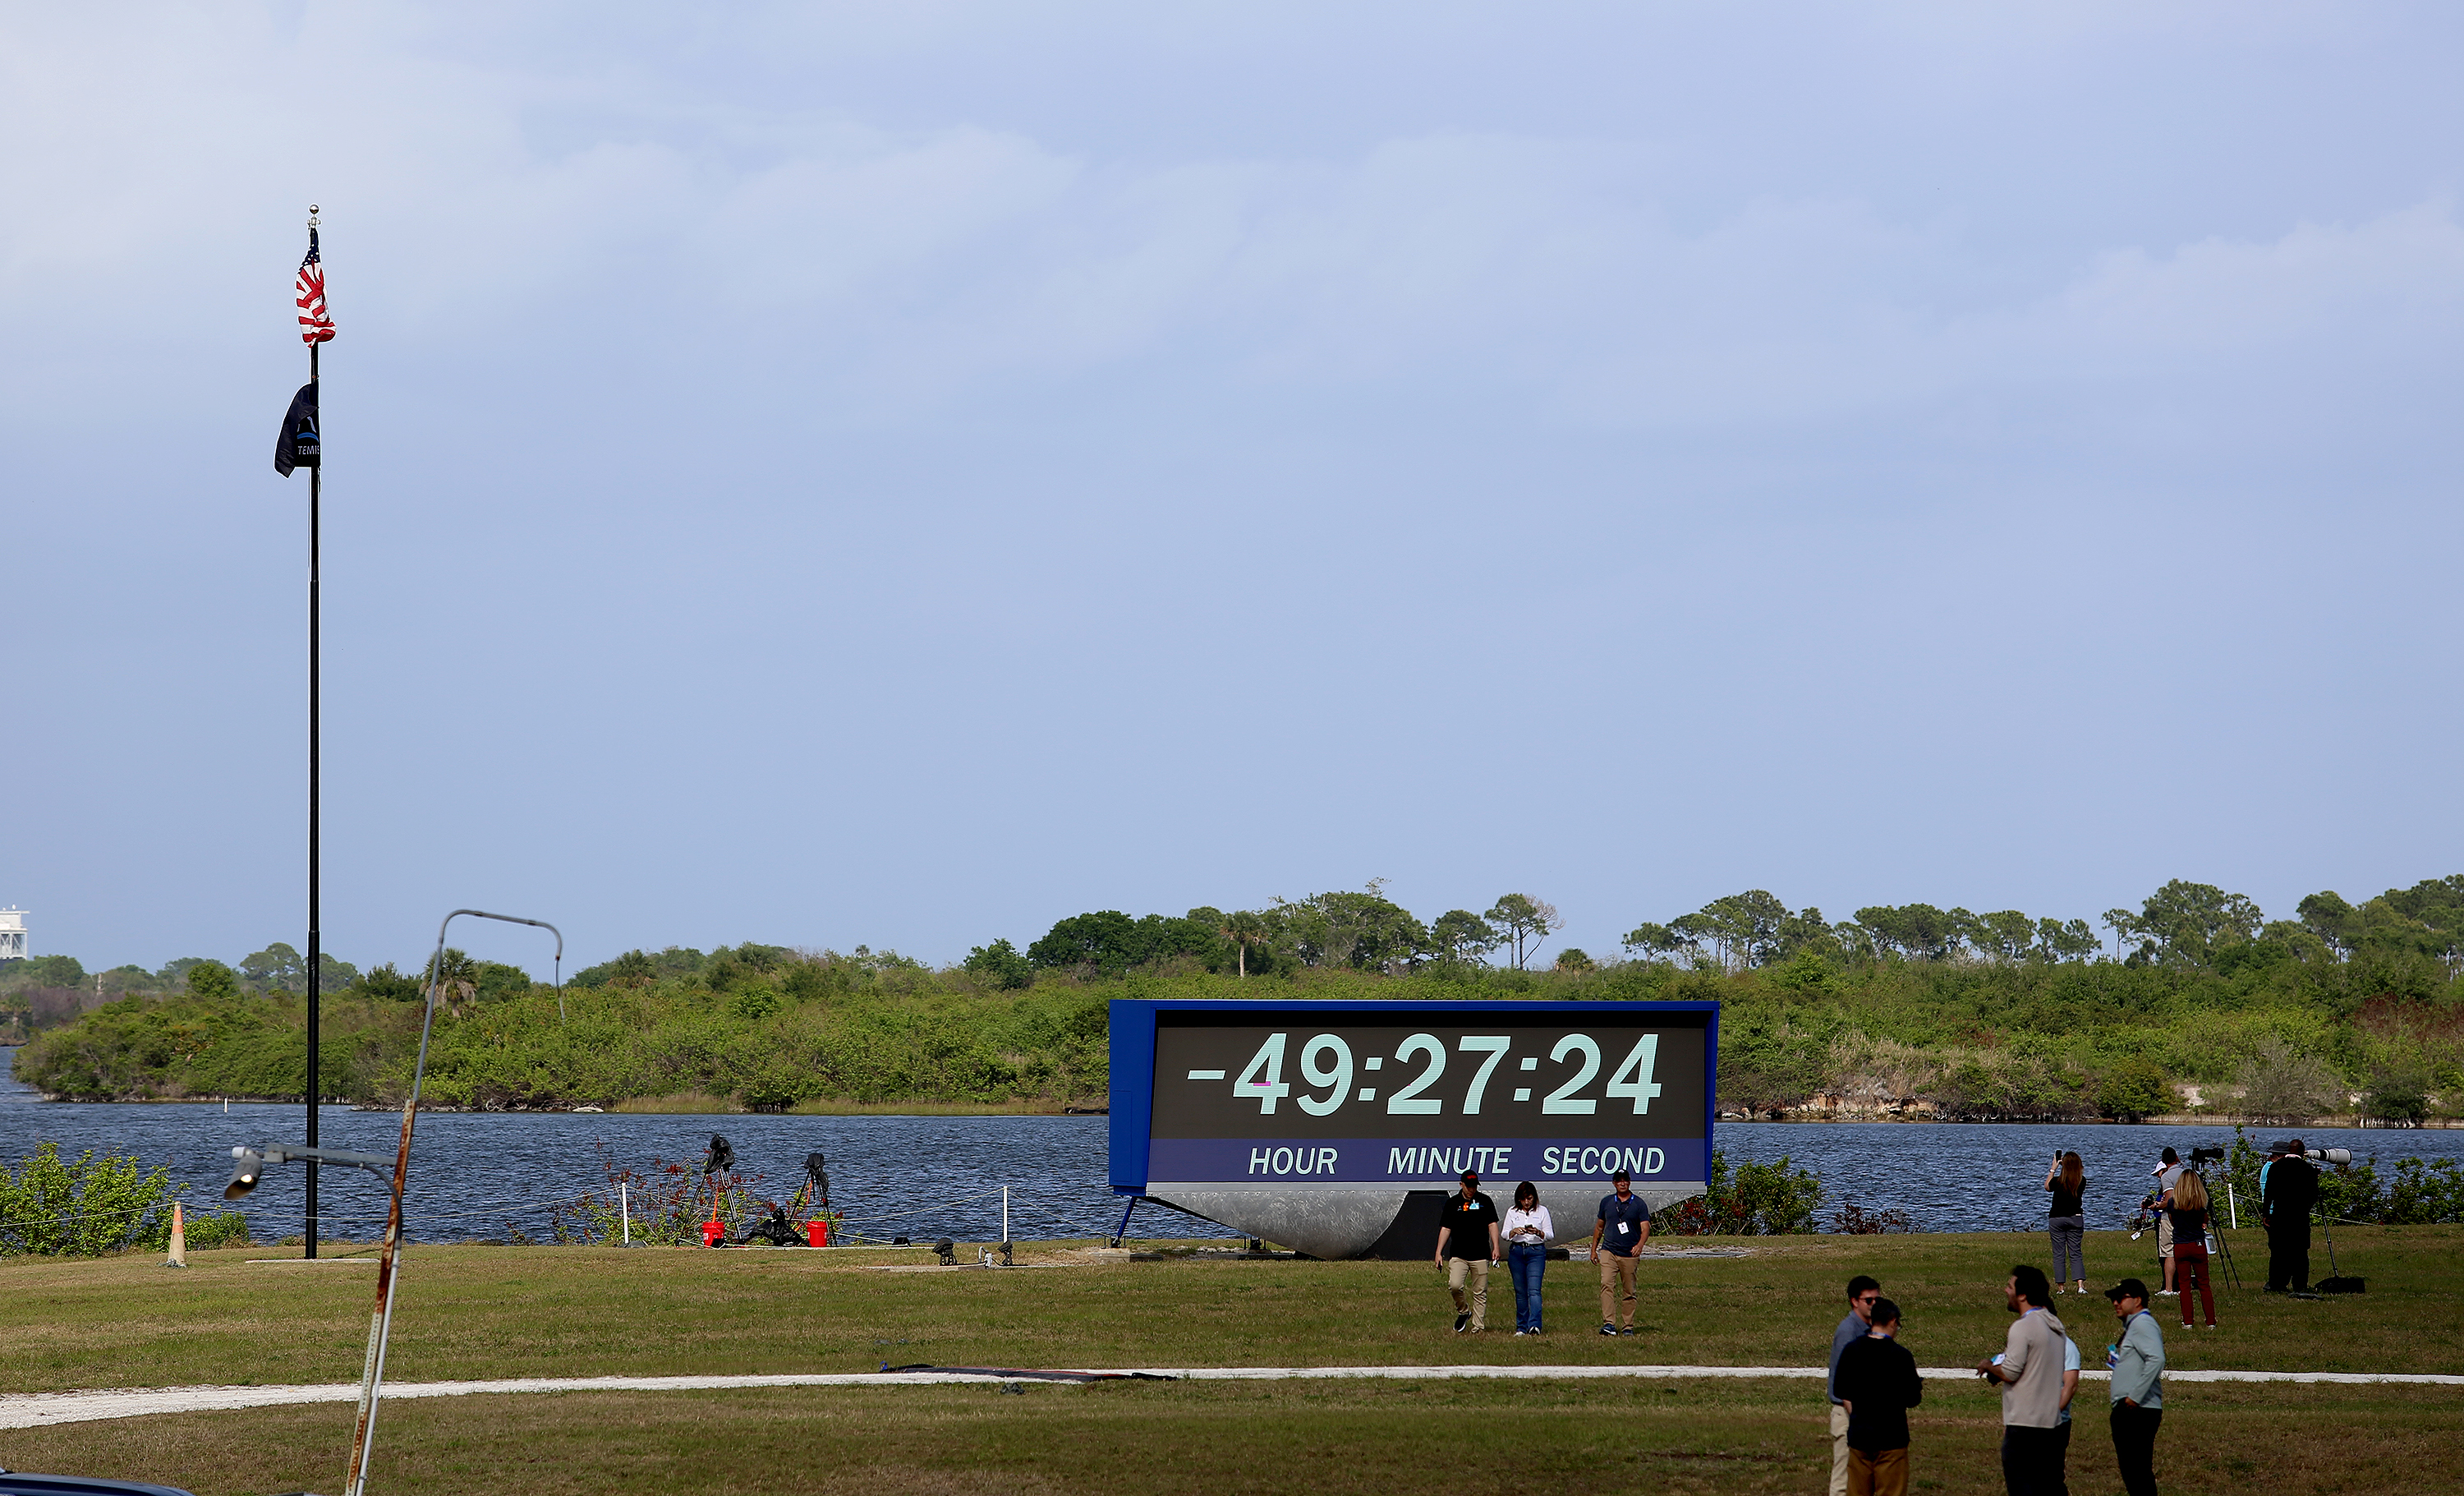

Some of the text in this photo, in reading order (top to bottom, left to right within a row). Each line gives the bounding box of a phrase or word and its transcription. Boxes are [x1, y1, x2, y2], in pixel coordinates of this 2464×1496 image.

[1187, 1033, 1662, 1116] -49:27:24
[1248, 1146, 1665, 1175] HOUR MINUTE SECOND
